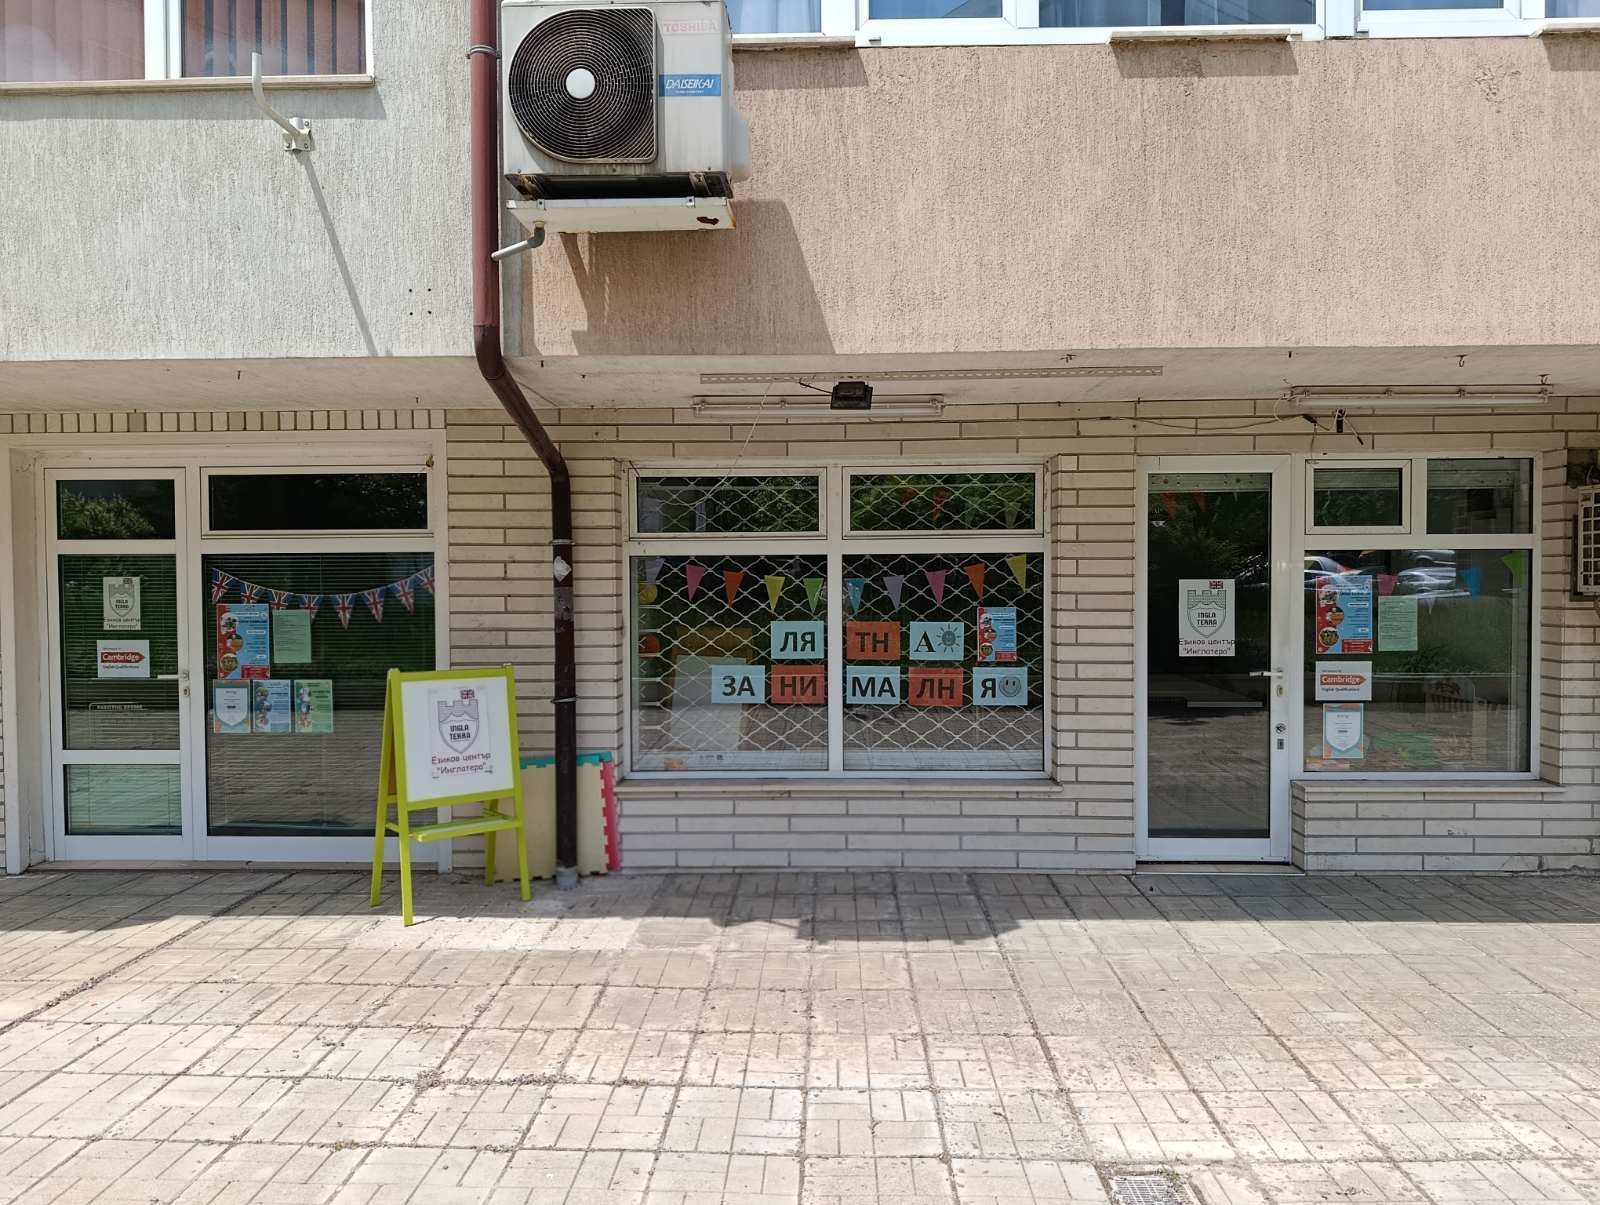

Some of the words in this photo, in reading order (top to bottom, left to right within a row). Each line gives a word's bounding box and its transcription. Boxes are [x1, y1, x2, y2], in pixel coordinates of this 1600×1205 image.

[665, 79, 715, 89] DAISEIKAI
[779, 631, 816, 653] ЛЯ
[102, 652, 140, 663] Cambridge
[1321, 675, 1361, 685] Cambridge
[721, 675, 756, 697] ЗА
[851, 676, 896, 698] МА
